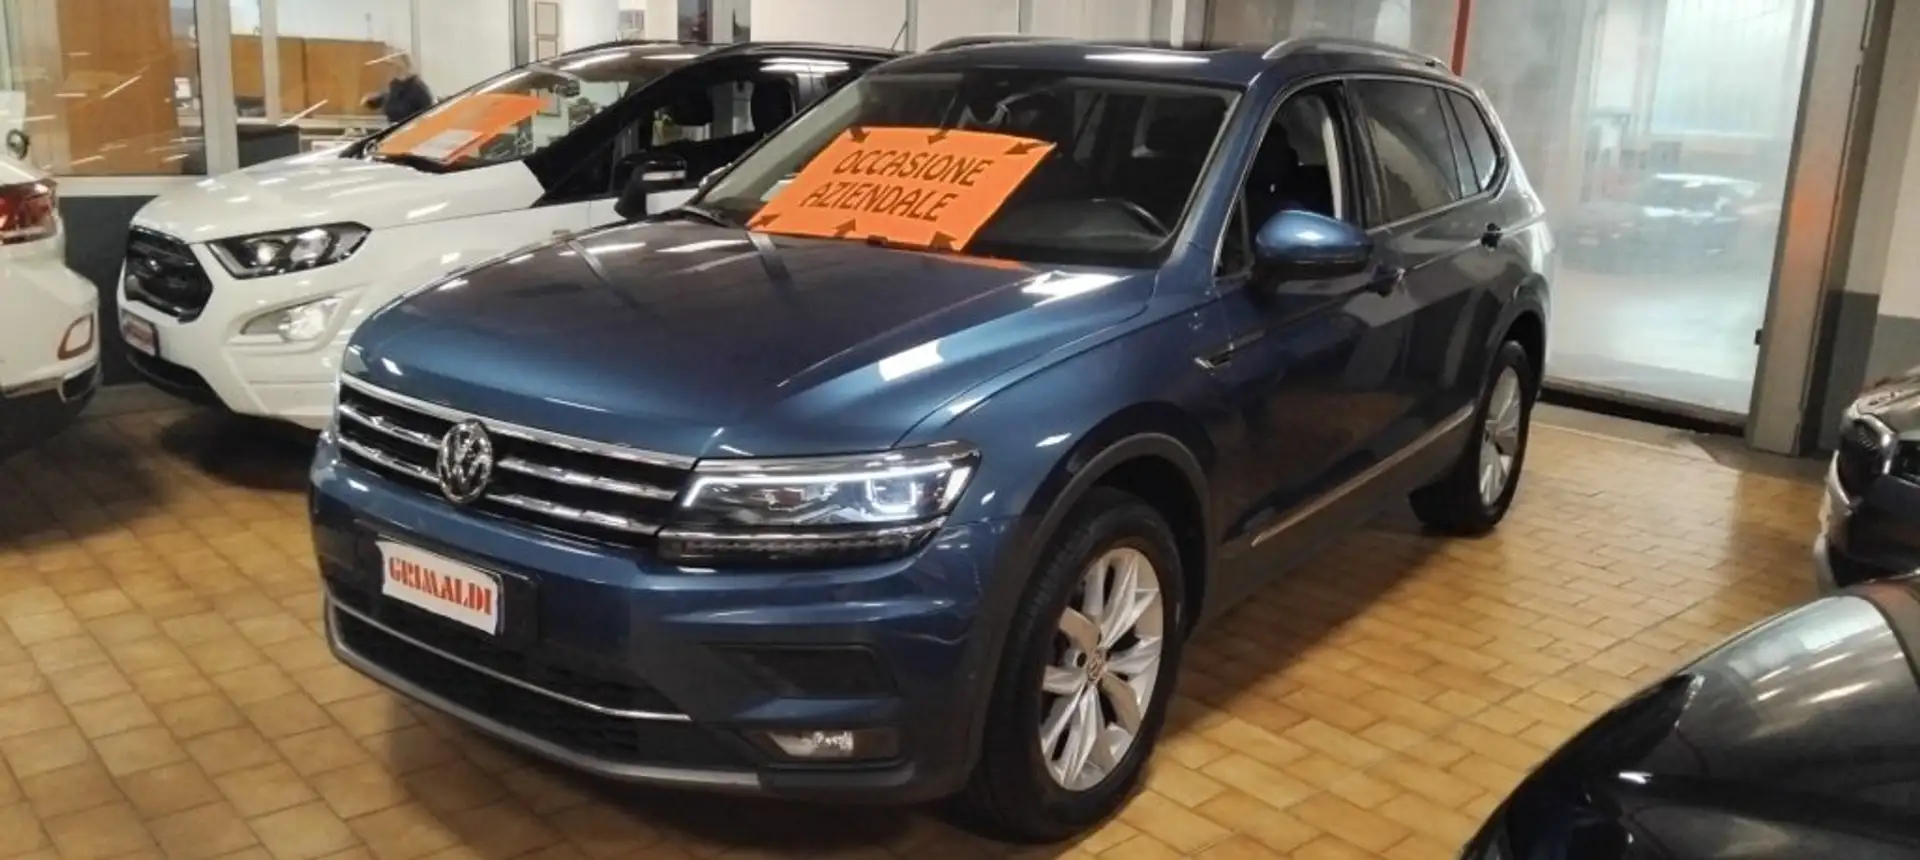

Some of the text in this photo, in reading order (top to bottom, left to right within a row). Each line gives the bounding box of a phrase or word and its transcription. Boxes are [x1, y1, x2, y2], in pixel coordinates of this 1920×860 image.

[832, 149, 995, 187] OCCASIONE
[800, 181, 958, 222] AZIENDALE
[389, 556, 492, 615] GRIMALDI
